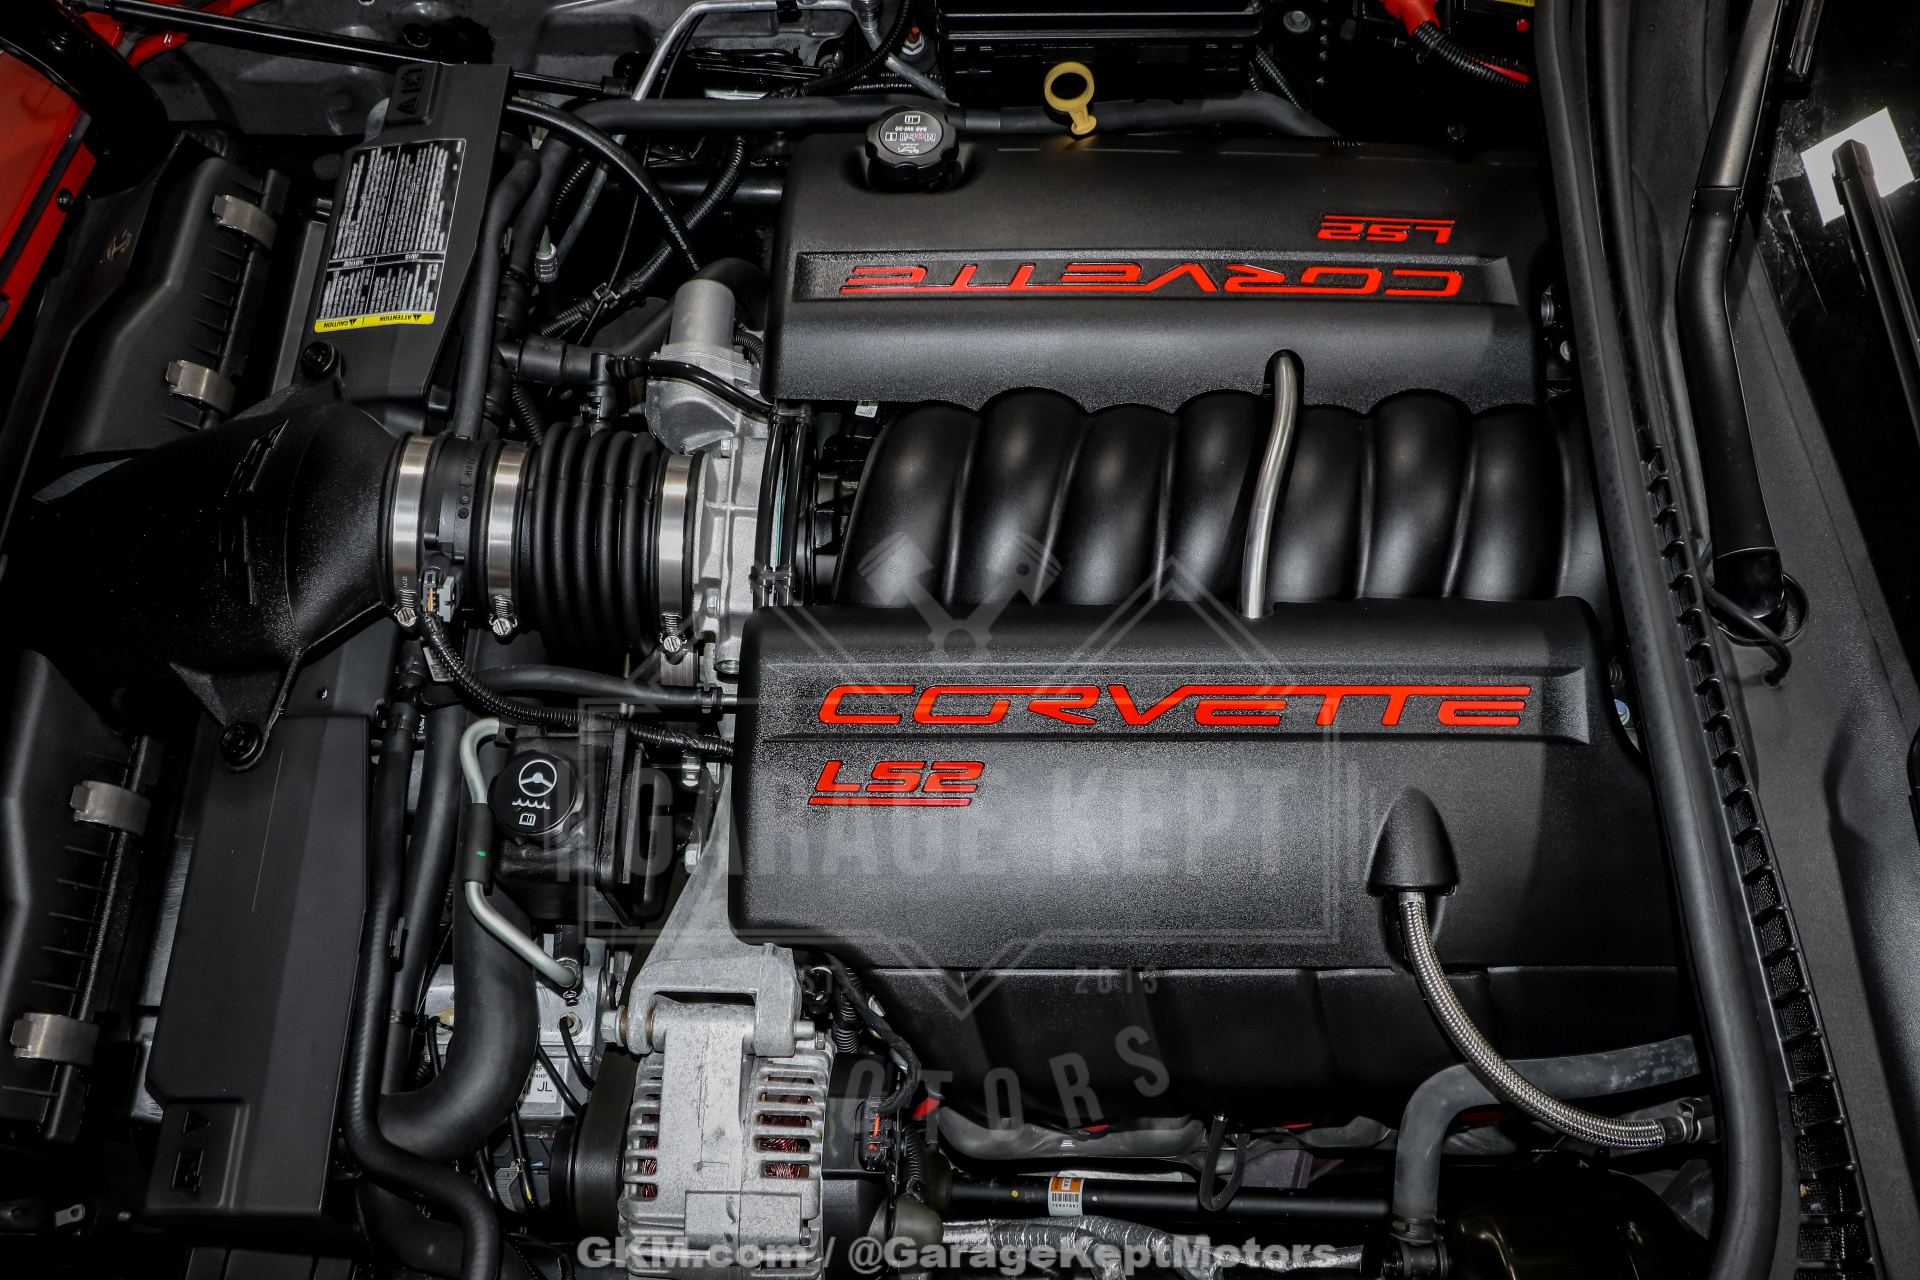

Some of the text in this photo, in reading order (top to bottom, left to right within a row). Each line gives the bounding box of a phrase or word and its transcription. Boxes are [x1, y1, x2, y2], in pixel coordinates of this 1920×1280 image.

[899, 131, 937, 142] Mobil
[663, 214, 688, 250] GOODYEAR
[1317, 219, 1455, 244] LS2
[839, 262, 1464, 297] CORVETTE
[323, 320, 350, 328] CAUTION
[379, 314, 414, 322] ATTENTION
[818, 684, 1532, 726] CORVETTE
[814, 760, 985, 793] LS2
[537, 1081, 553, 1092] JL
